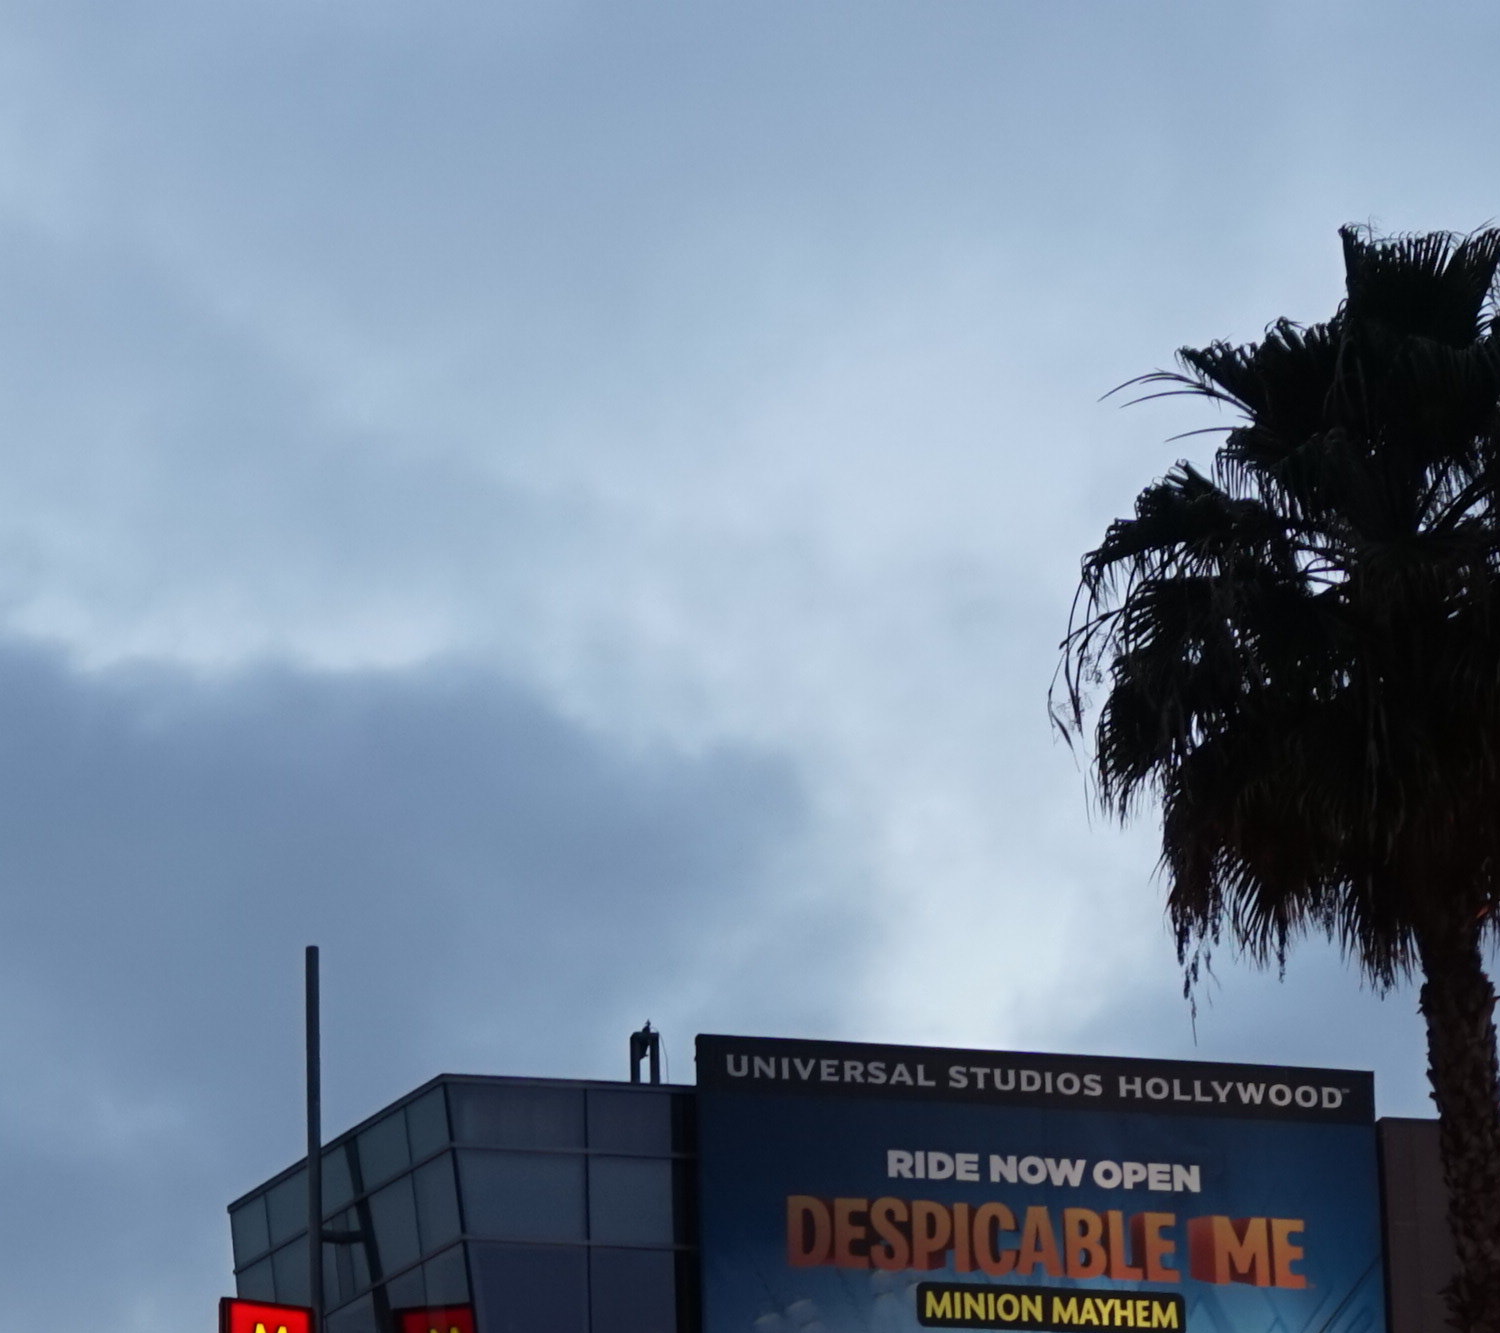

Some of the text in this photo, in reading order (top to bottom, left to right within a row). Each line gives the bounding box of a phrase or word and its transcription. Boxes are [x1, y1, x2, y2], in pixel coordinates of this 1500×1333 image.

[726, 1053, 1343, 1110] UNIVERSAL STUDIOS HOLLYWOOD
[887, 1149, 1201, 1192] RIDE NOW OPEN
[786, 1195, 1309, 1290] DESPICABLE ME
[925, 1290, 1179, 1330] MINION MAYHEM
